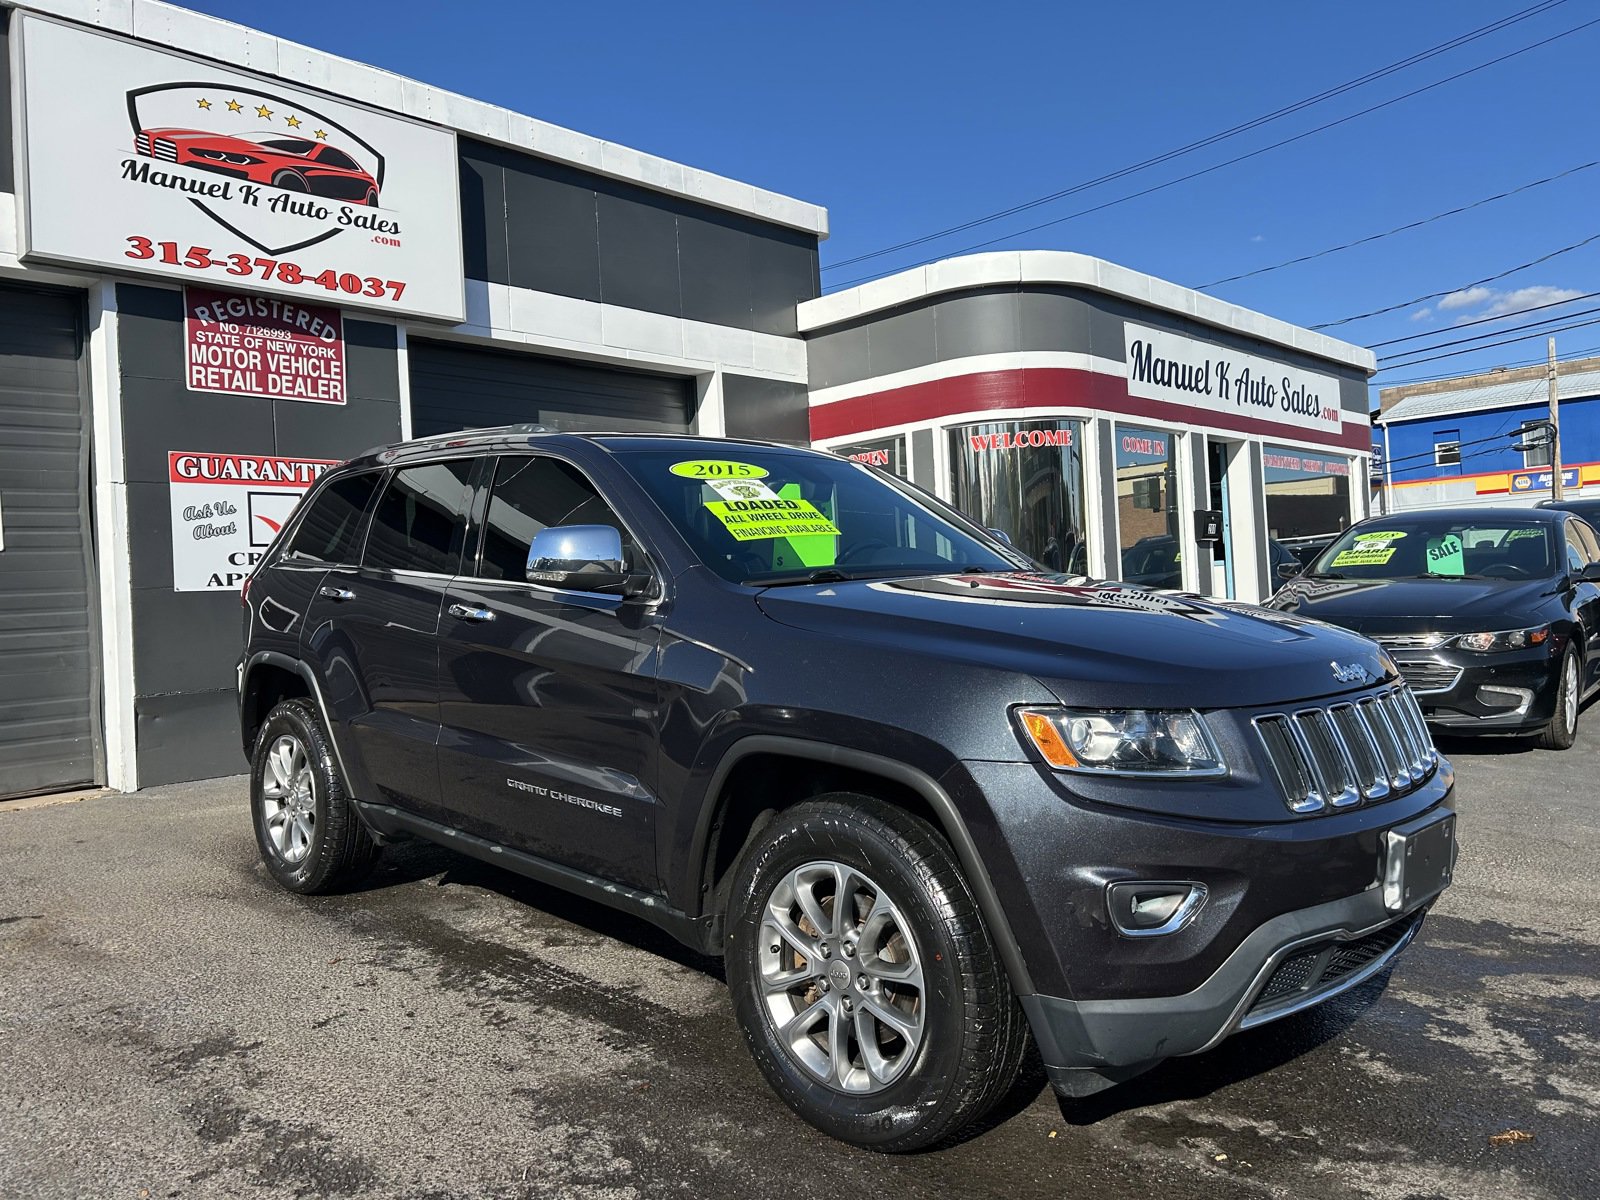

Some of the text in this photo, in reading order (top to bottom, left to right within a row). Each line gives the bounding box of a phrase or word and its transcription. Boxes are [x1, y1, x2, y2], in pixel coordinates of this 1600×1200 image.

[121, 159, 401, 234] Manuel K Auto Sales
[371, 235, 401, 247] .com
[125, 236, 406, 301] 315-378-4037
[194, 298, 337, 344] REGISTERED
[219, 321, 242, 335] NO.
[196, 331, 336, 360] STATE OF NEW YORK
[192, 344, 341, 380] MOTOR VEHICLE
[192, 366, 342, 401] RETAIL DEALER
[1131, 340, 1212, 395] Manuel
[1215, 360, 1231, 400] K
[1235, 367, 1278, 406] Auto
[970, 430, 1072, 452] WELCOME
[1122, 436, 1165, 456] COME IN
[693, 464, 751, 476] 2015
[183, 501, 237, 521] Ask Us
[723, 499, 800, 512] LOADED
[724, 511, 820, 523] ALL WHEEL DRIVE
[193, 522, 237, 540] About
[733, 524, 836, 538] FINANCING AVAILABLE
[1429, 541, 1460, 561] SALE
[1330, 661, 1368, 685] Jeep
[507, 778, 622, 817] GRAND CHEROKEE
